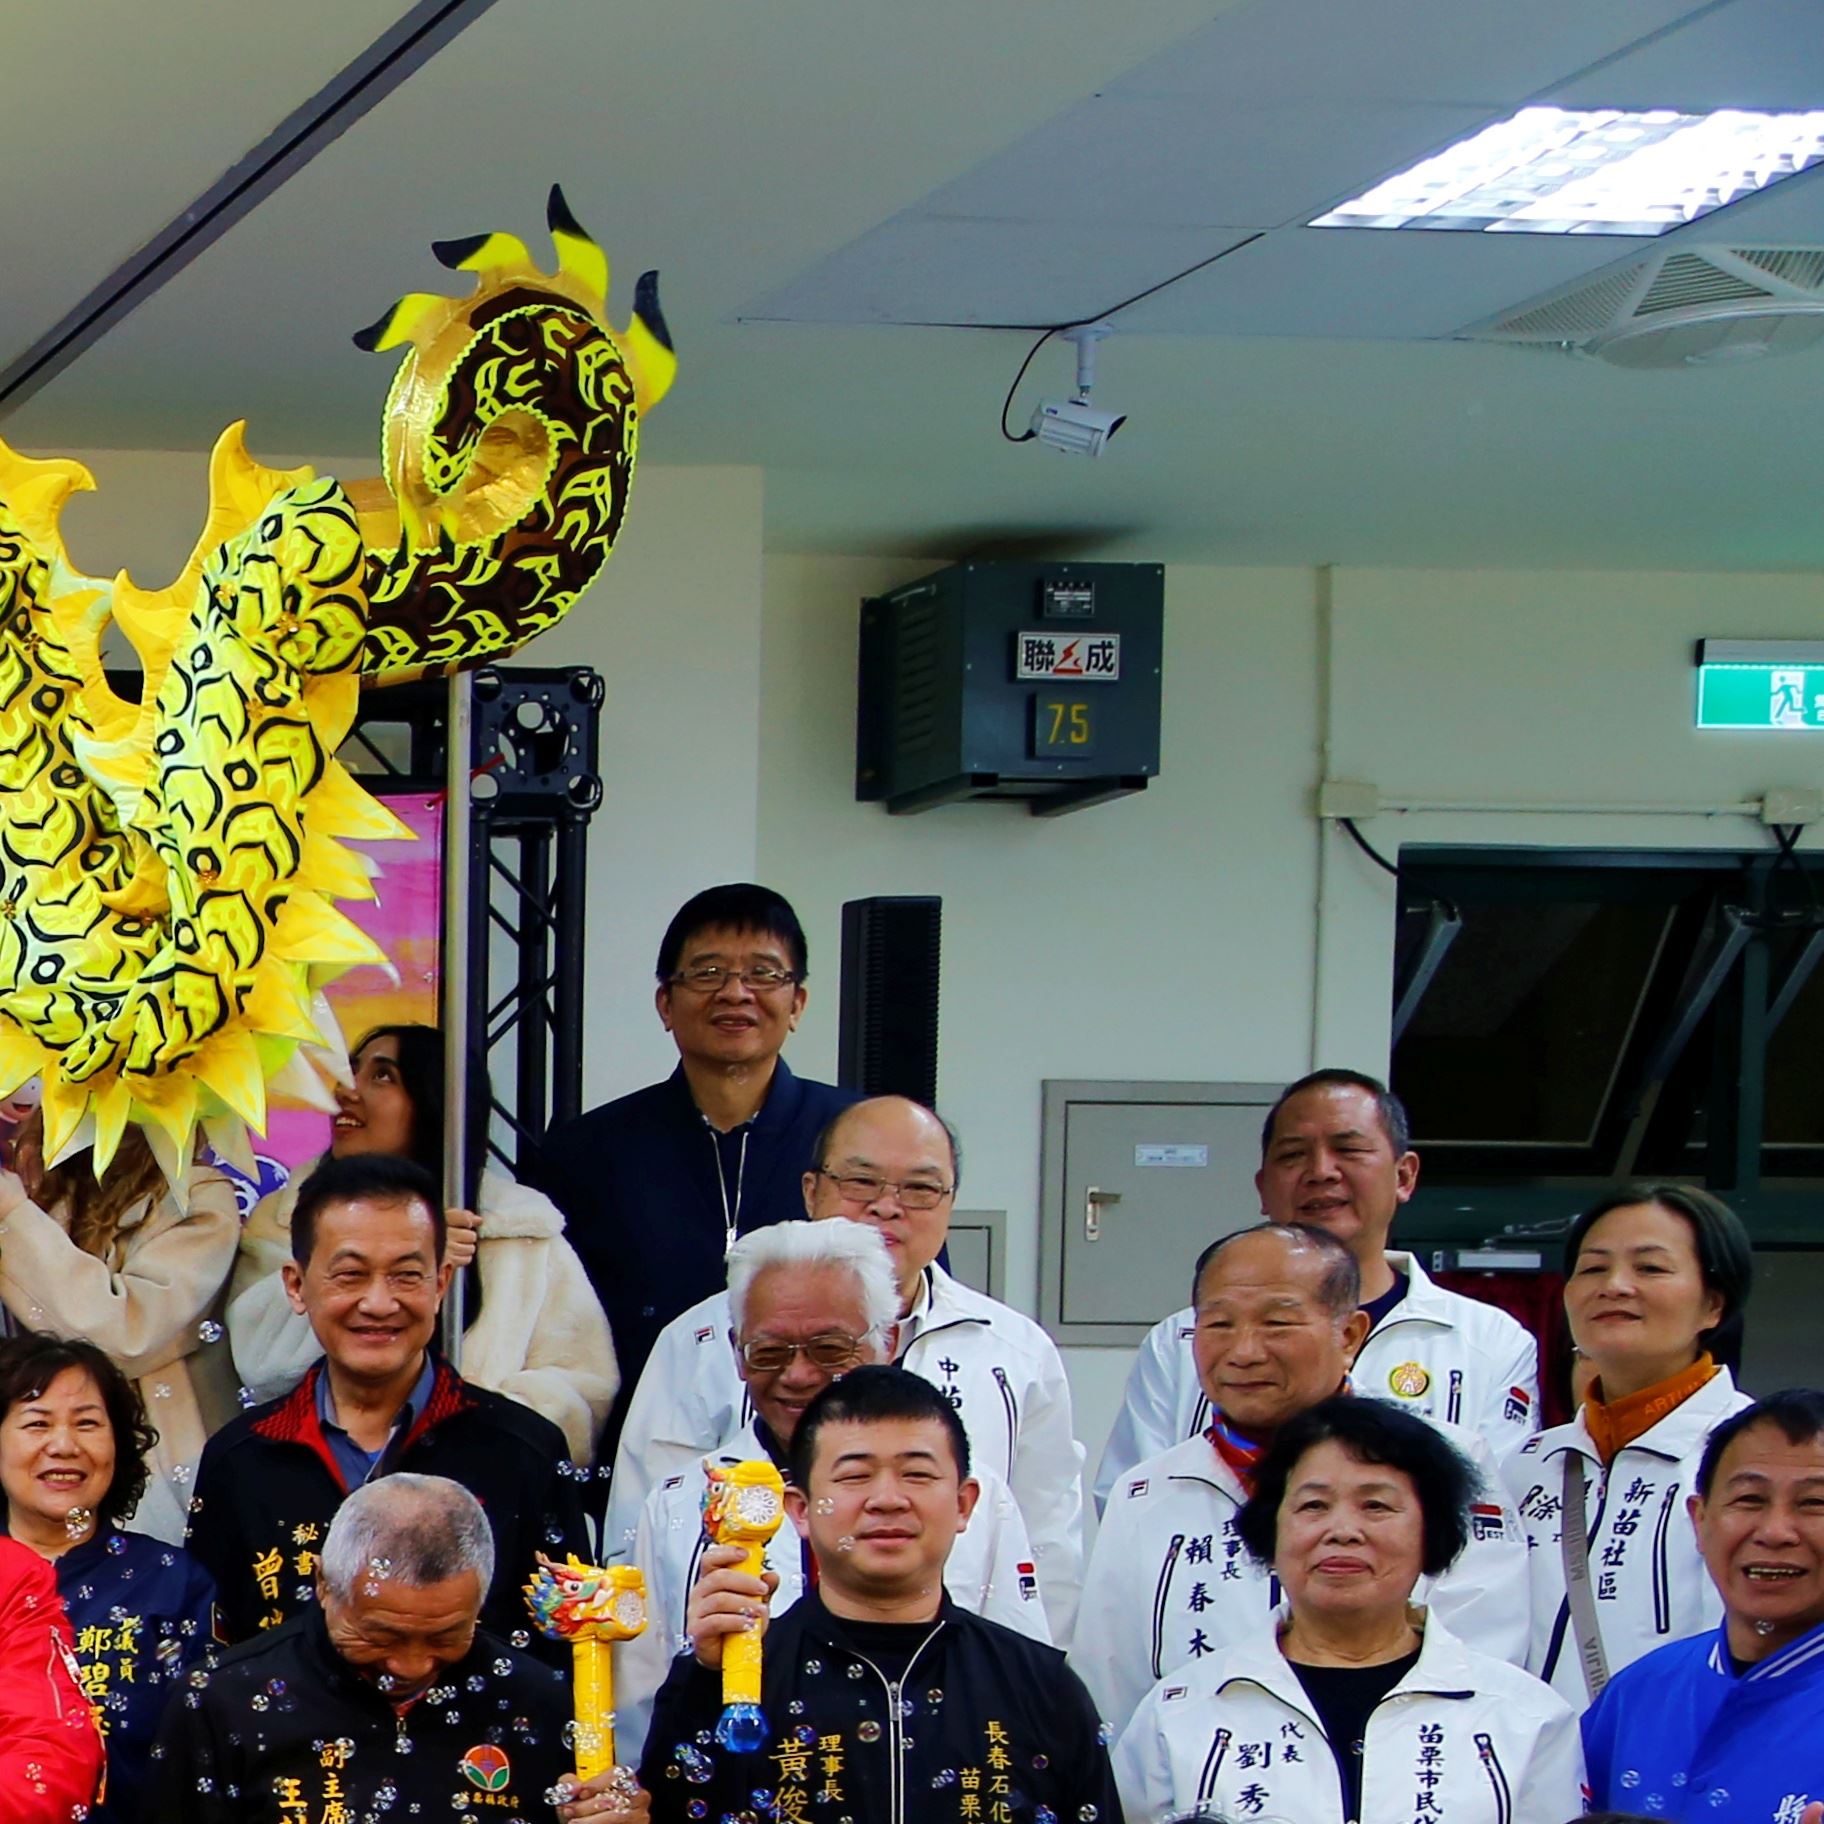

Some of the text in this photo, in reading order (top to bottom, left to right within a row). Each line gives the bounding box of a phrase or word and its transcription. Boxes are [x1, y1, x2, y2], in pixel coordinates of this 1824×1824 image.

[1598, 1476, 1655, 1600] 新苗社區
[818, 1734, 844, 1801] 理事長
[1280, 1721, 1305, 1764] 代表
